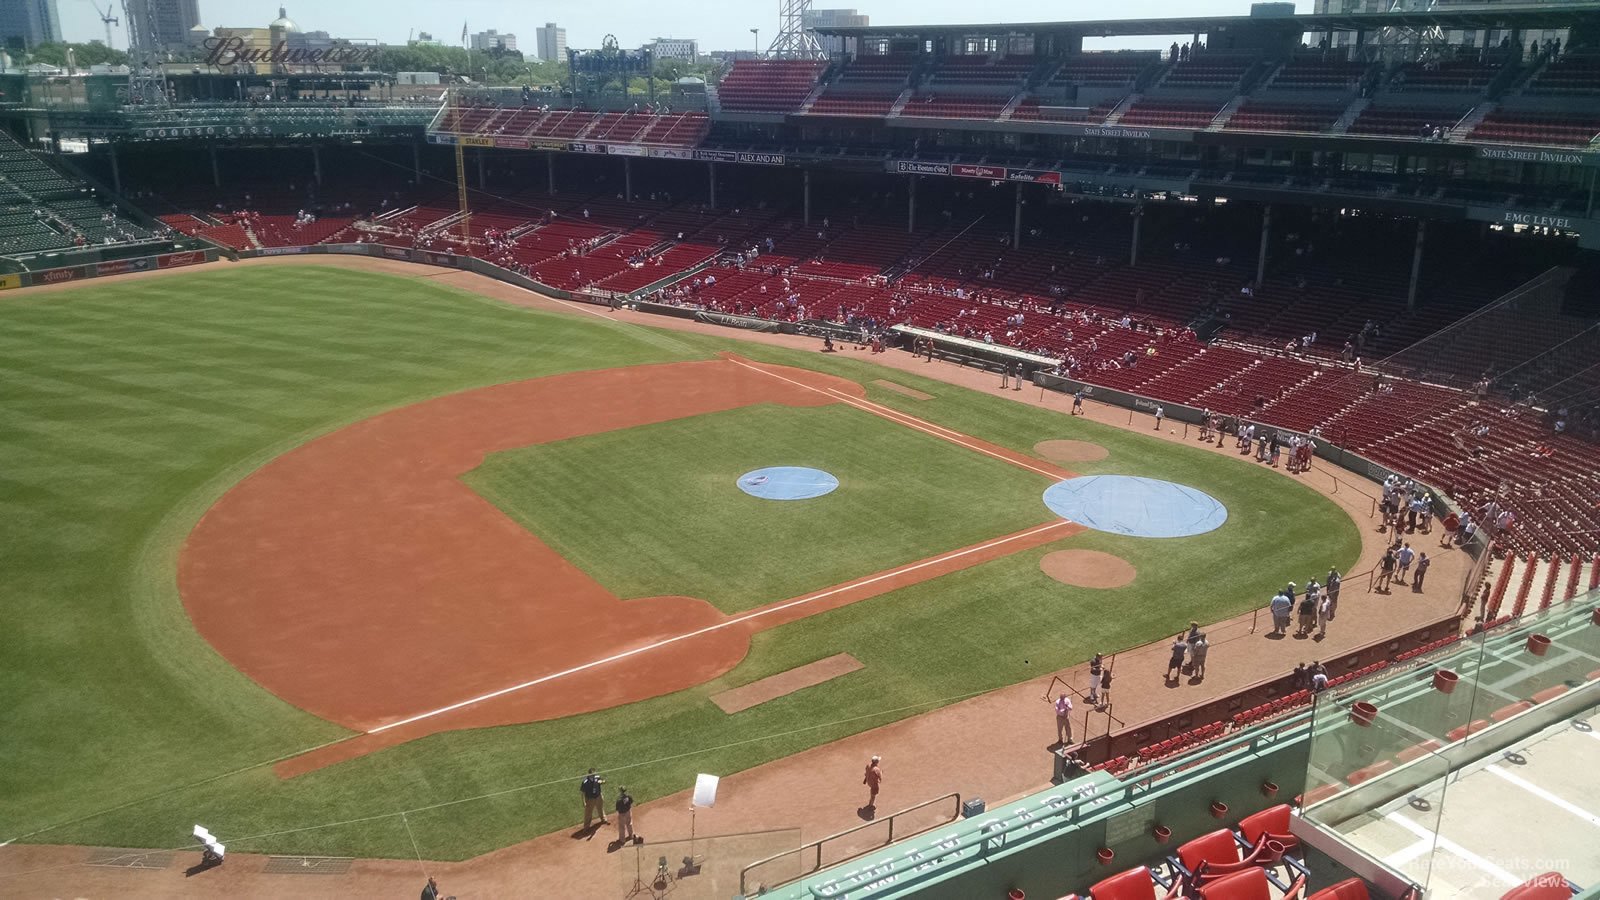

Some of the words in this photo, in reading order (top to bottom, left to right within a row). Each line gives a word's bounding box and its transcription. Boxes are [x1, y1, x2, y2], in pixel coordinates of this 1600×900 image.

[203, 37, 377, 66] Budweiser
[1084, 127, 1100, 136] STATE
[1101, 128, 1122, 137] STREET
[1123, 129, 1151, 139] PAVILION
[465, 137, 489, 146] STANLEY
[739, 154, 755, 162] ALEX
[756, 155, 770, 163] AND
[771, 155, 783, 164] ANI
[1482, 148, 1507, 160] STATE
[1507, 149, 1537, 161] STREET
[1540, 152, 1583, 163] PAVILION
[908, 163, 917, 171] The
[917, 164, 933, 172] Boston
[933, 165, 947, 174] Globe
[1504, 212, 1530, 223] EMC
[1533, 216, 1572, 228] LEVEL
[43, 268, 75, 282] xfinity
